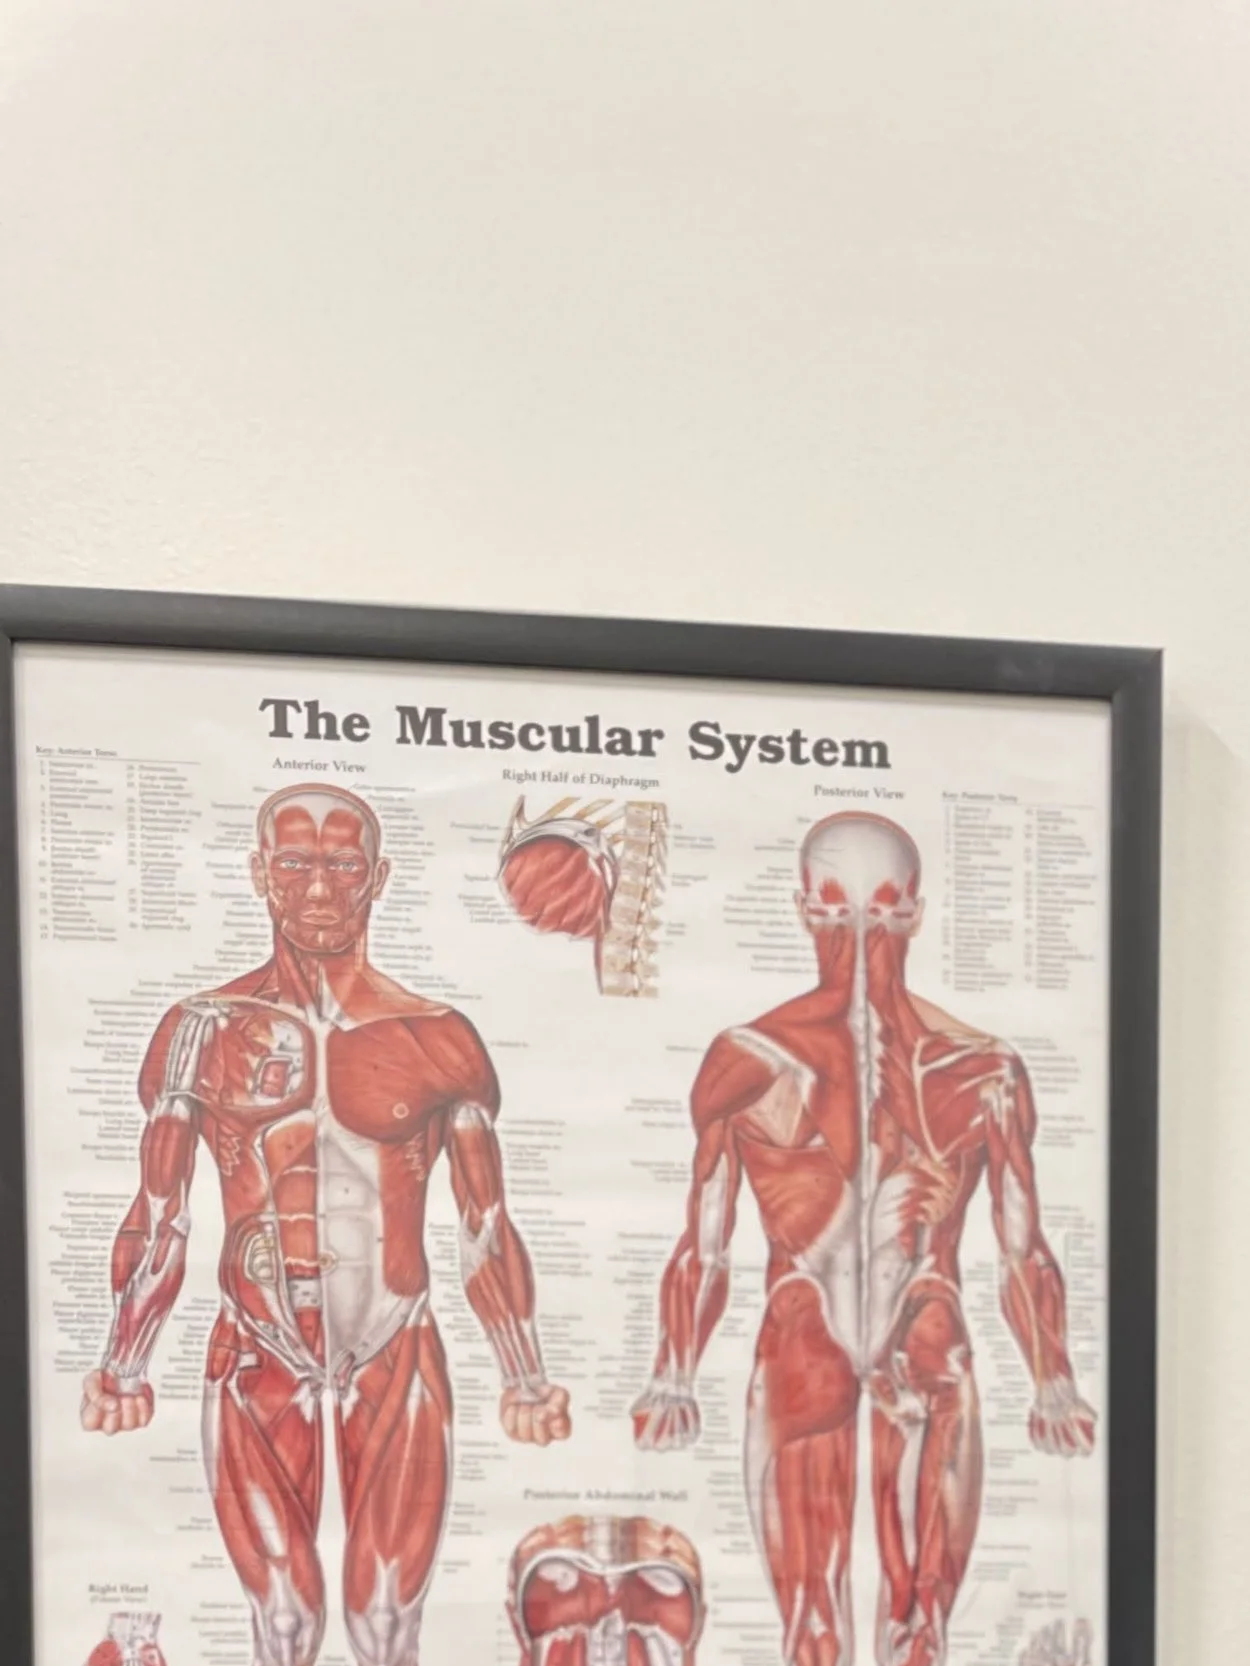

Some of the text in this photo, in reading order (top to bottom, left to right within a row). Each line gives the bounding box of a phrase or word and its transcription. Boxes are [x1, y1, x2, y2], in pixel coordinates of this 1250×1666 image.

[258, 698, 891, 773] The Muscular System
[272, 757, 367, 774] Anterior View
[502, 769, 660, 790] Right Half of Diaphragm
[813, 784, 905, 800] Posterior View
[523, 1488, 689, 1502] Posterior Abdominal Wall
